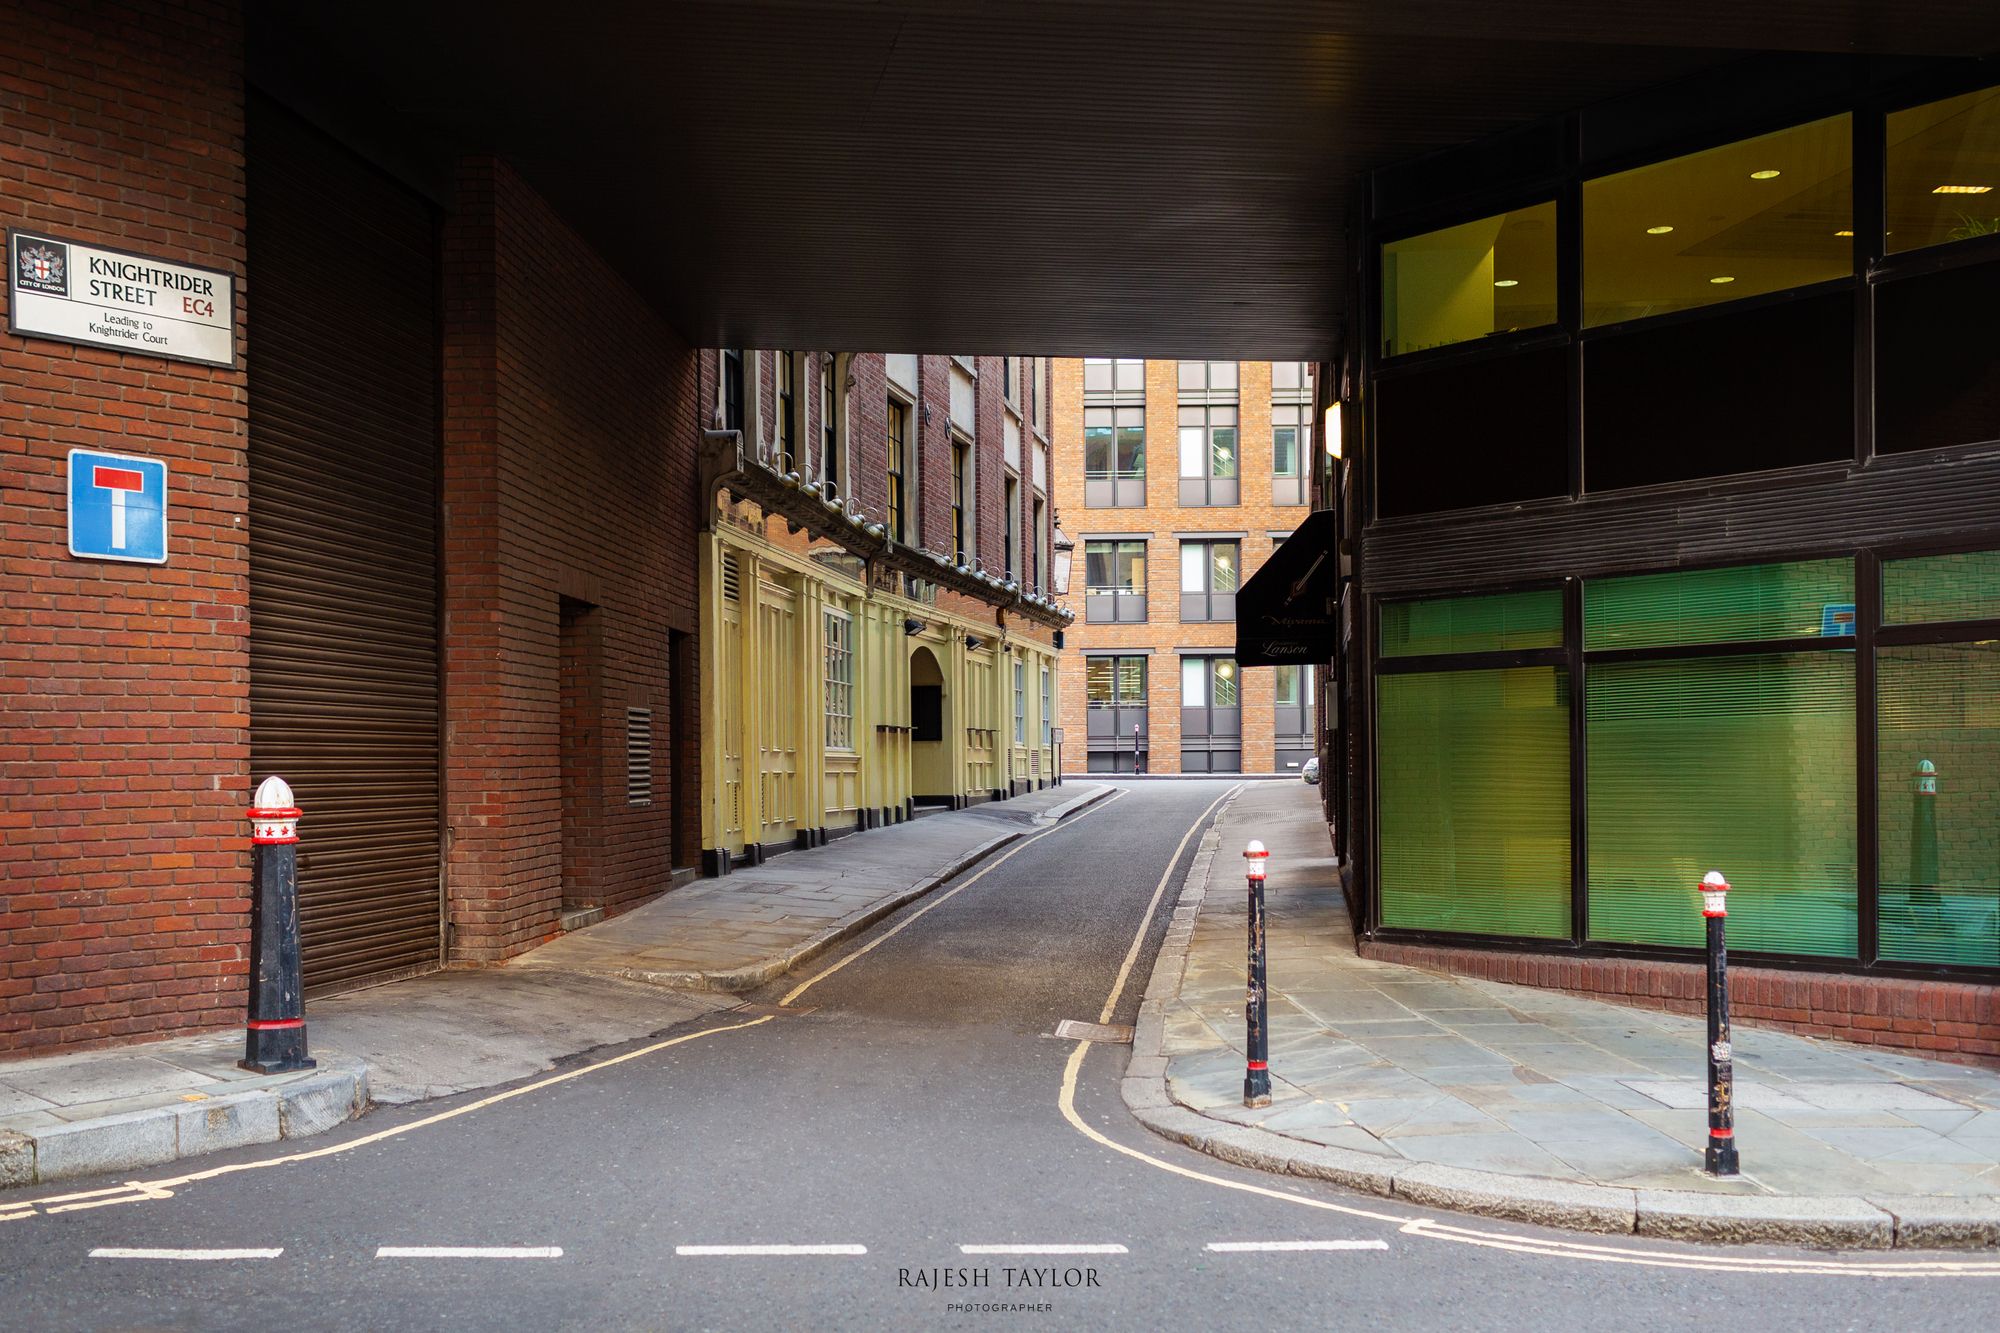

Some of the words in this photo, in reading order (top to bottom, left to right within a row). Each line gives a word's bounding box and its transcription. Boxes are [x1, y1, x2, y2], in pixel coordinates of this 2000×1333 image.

[89, 257, 214, 297] KNIGHTRIDER
[42, 284, 65, 292] LONDON
[90, 279, 157, 306] STREET
[183, 296, 214, 317] EC4
[104, 312, 139, 329] Leading
[143, 321, 153, 330] to
[89, 322, 138, 340] Knightrider
[142, 331, 168, 345] Court
[1260, 640, 1308, 657] Lanson
